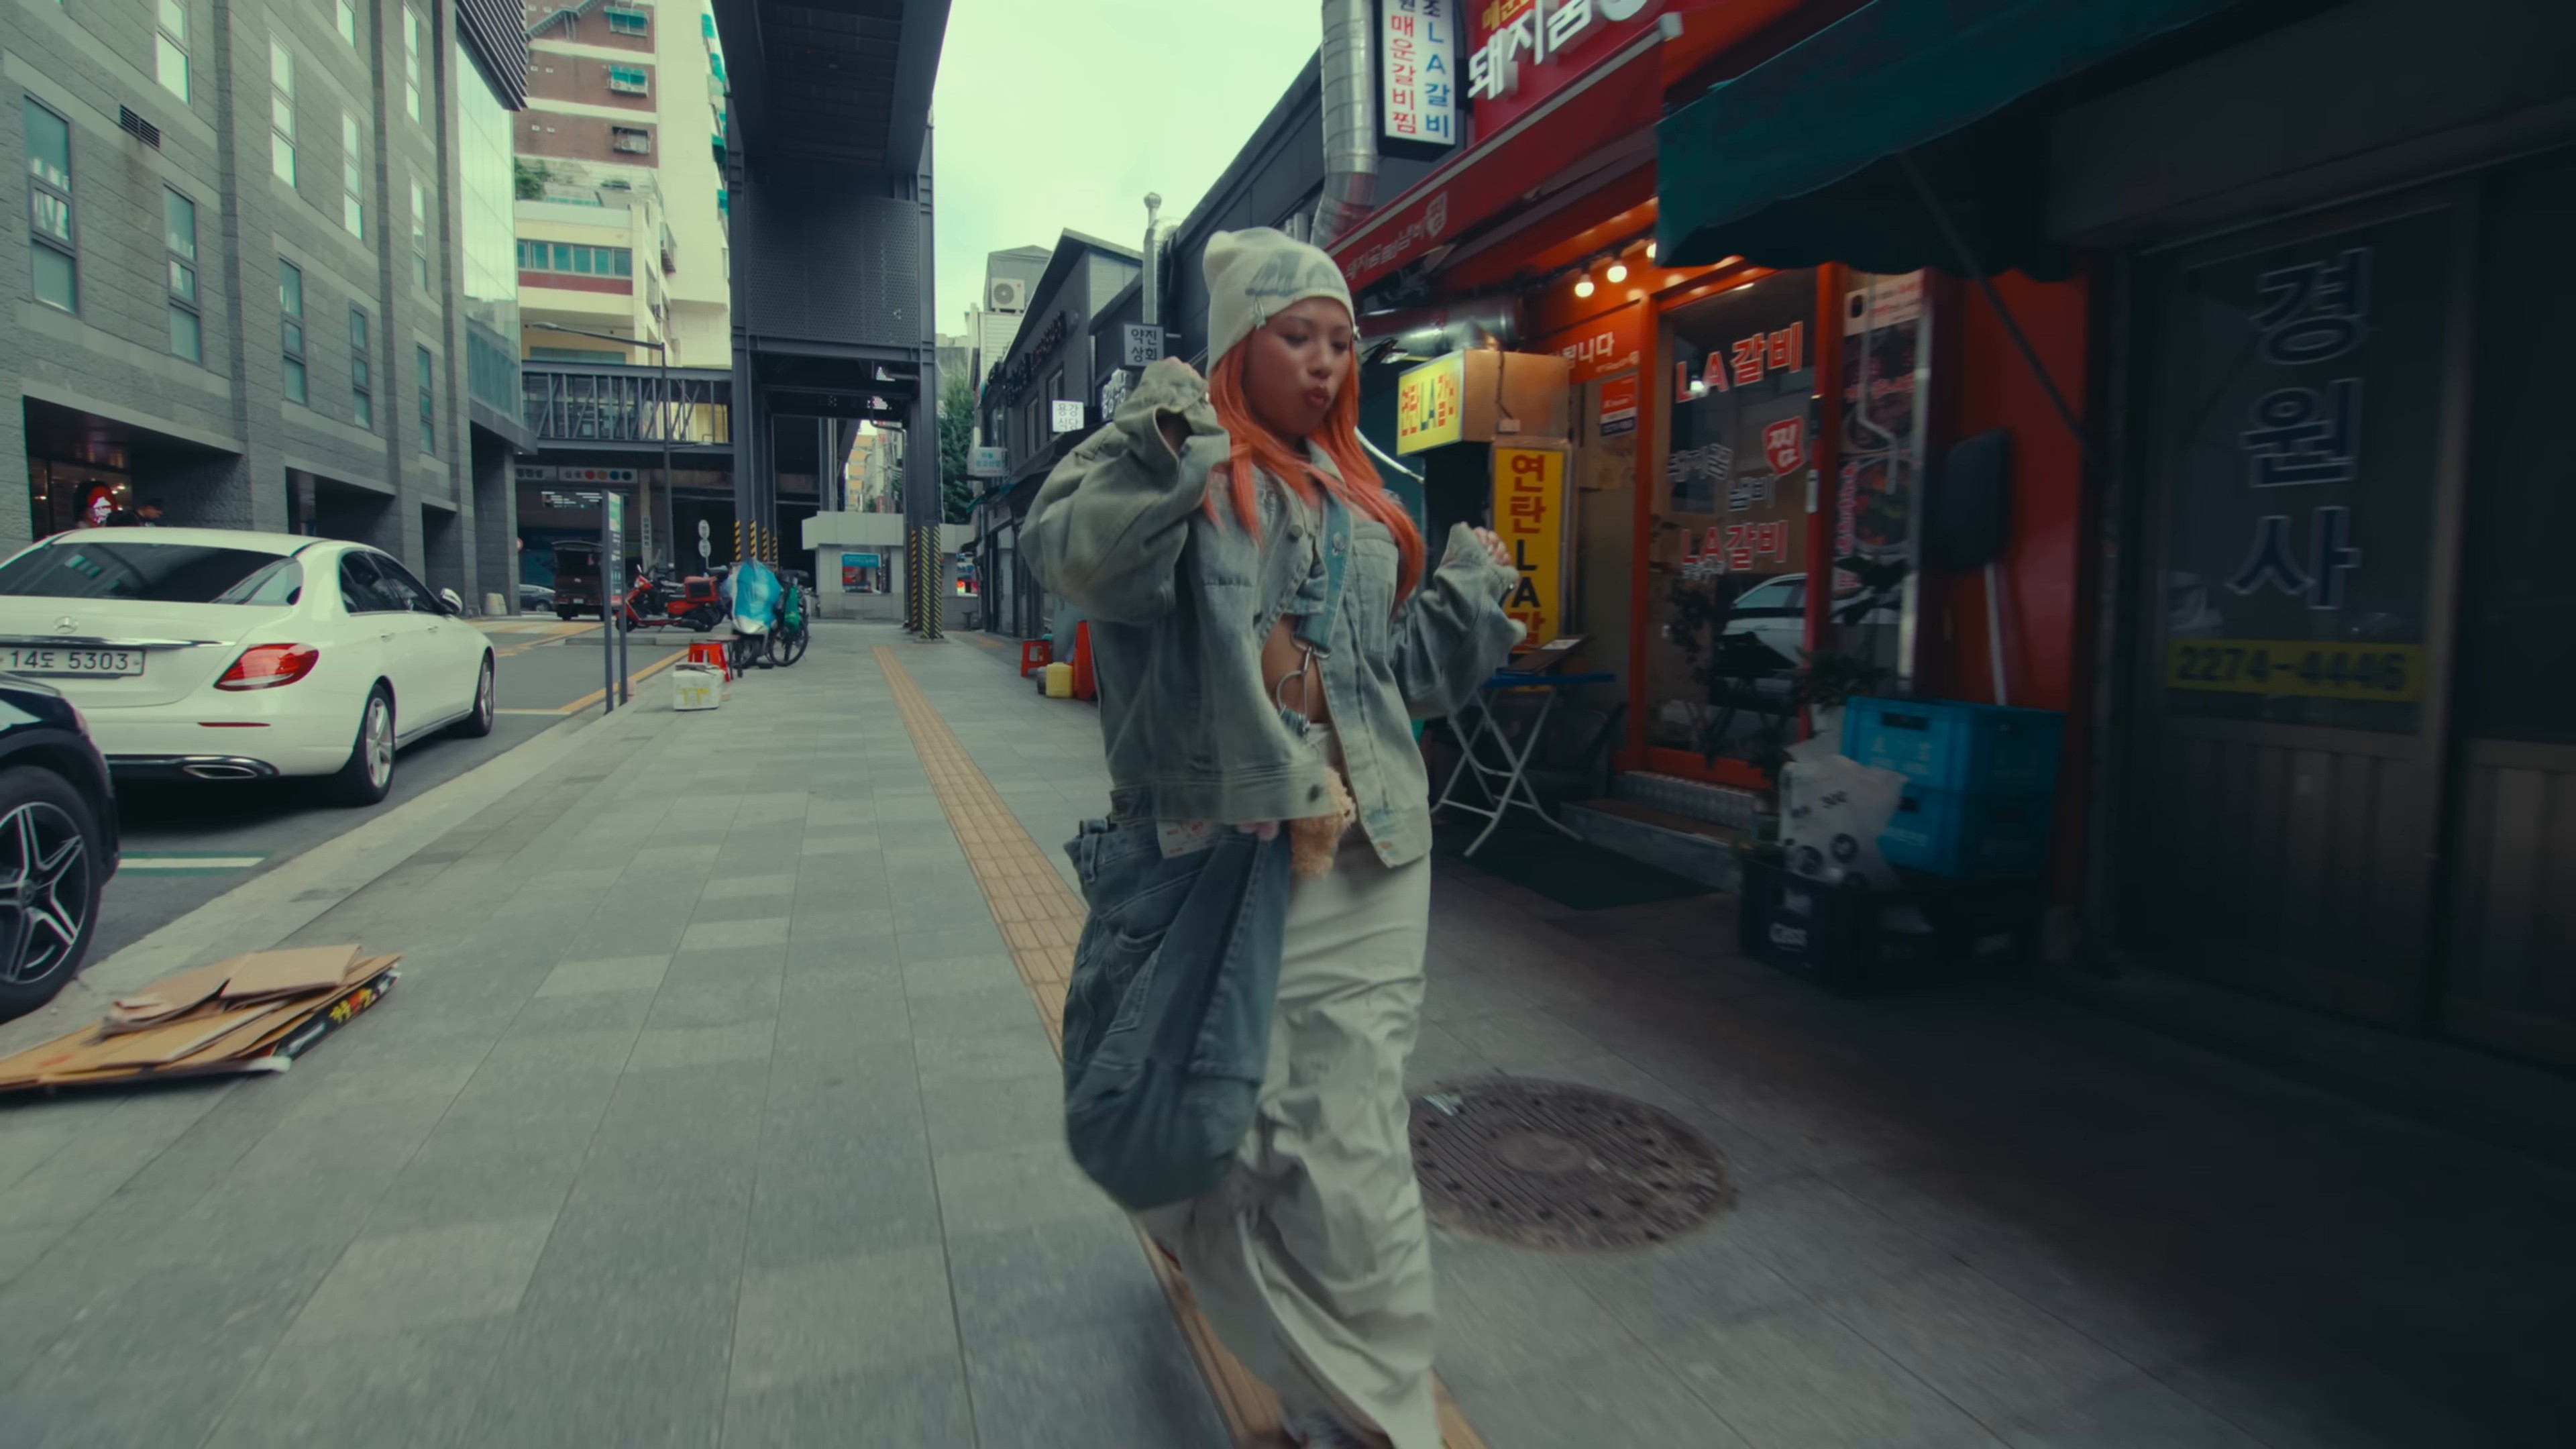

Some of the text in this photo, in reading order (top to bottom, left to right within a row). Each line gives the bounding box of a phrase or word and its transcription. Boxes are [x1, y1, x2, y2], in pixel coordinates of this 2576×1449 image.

[1390, 15, 1417, 135] 매운갈비찜
[1425, 21, 1451, 139] LA갈비
[1131, 328, 1157, 345] 약진
[1131, 346, 1157, 363] 상회
[1676, 321, 1804, 404] LA갈비
[2224, 245, 2373, 611] 경원사
[1680, 519, 1788, 571] LA갈비
[11, 649, 129, 670] 14도 5303
